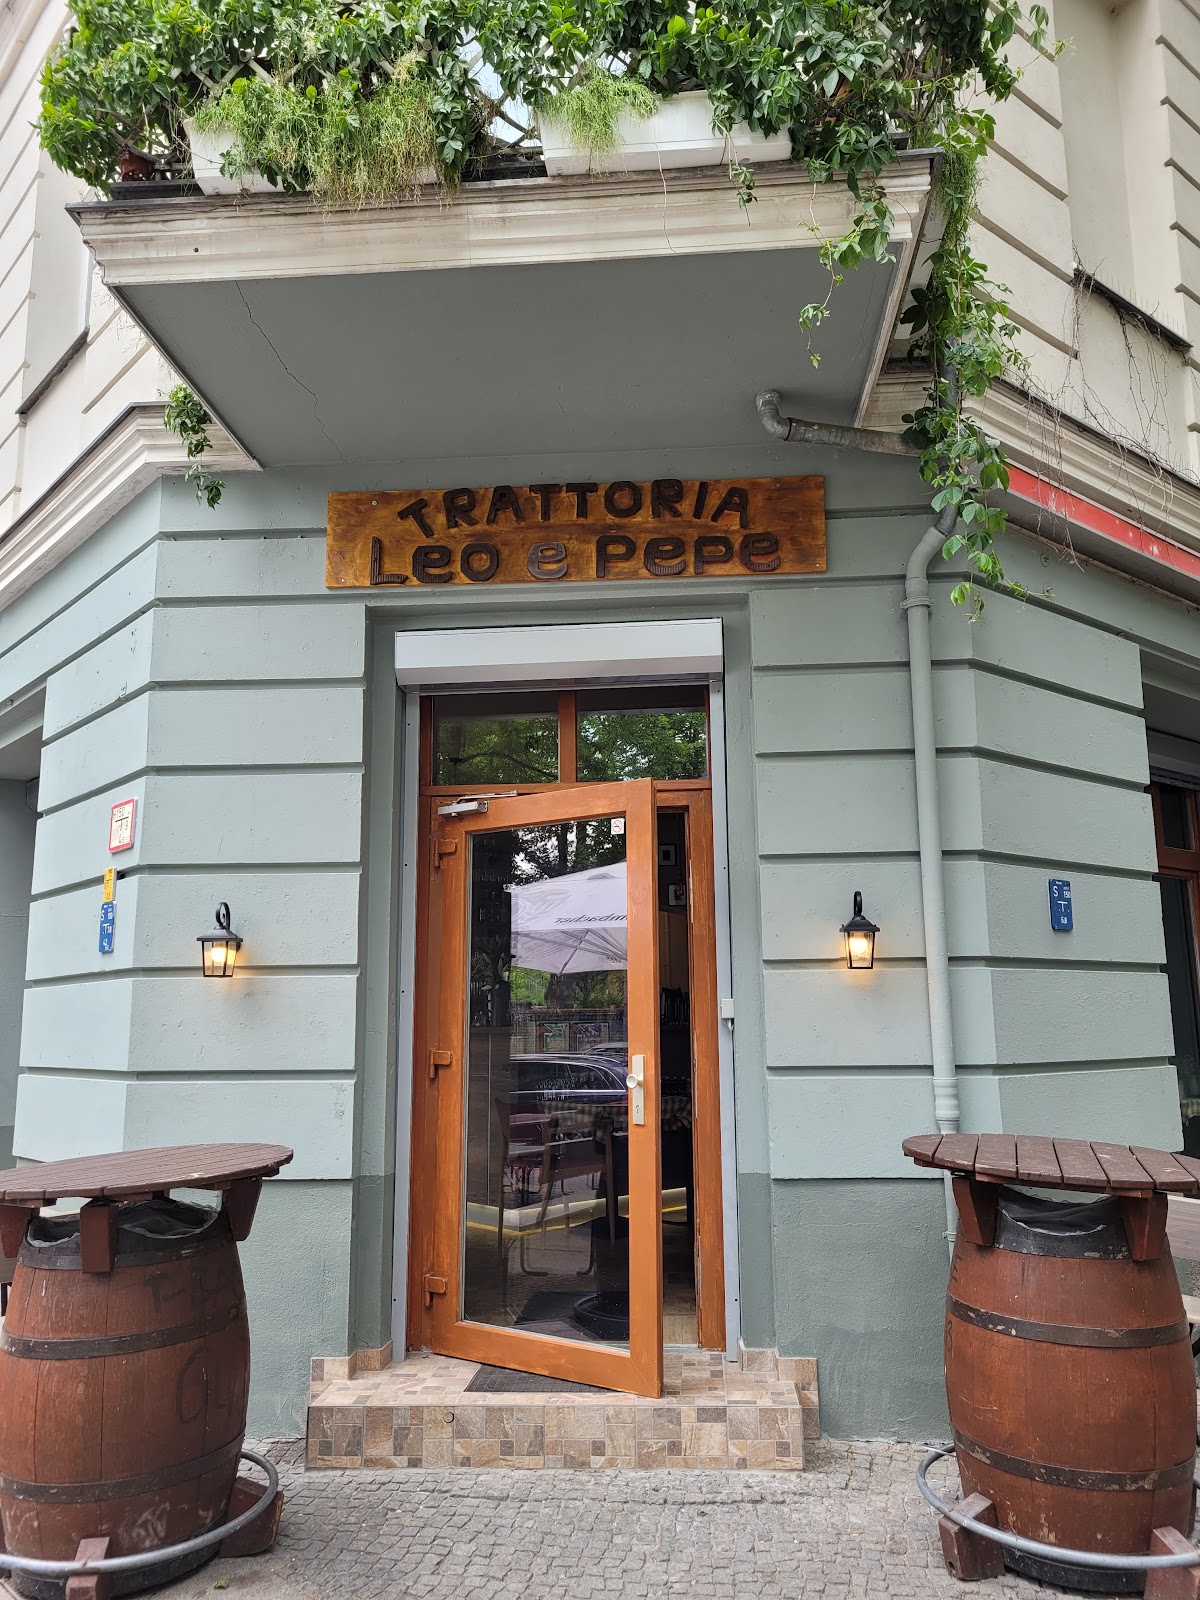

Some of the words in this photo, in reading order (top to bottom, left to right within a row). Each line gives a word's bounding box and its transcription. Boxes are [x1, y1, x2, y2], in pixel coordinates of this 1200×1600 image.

[397, 478, 749, 538] TRATTORIA
[527, 541, 568, 580] e
[1053, 886, 1058, 897] S
[100, 909, 105, 921] S
